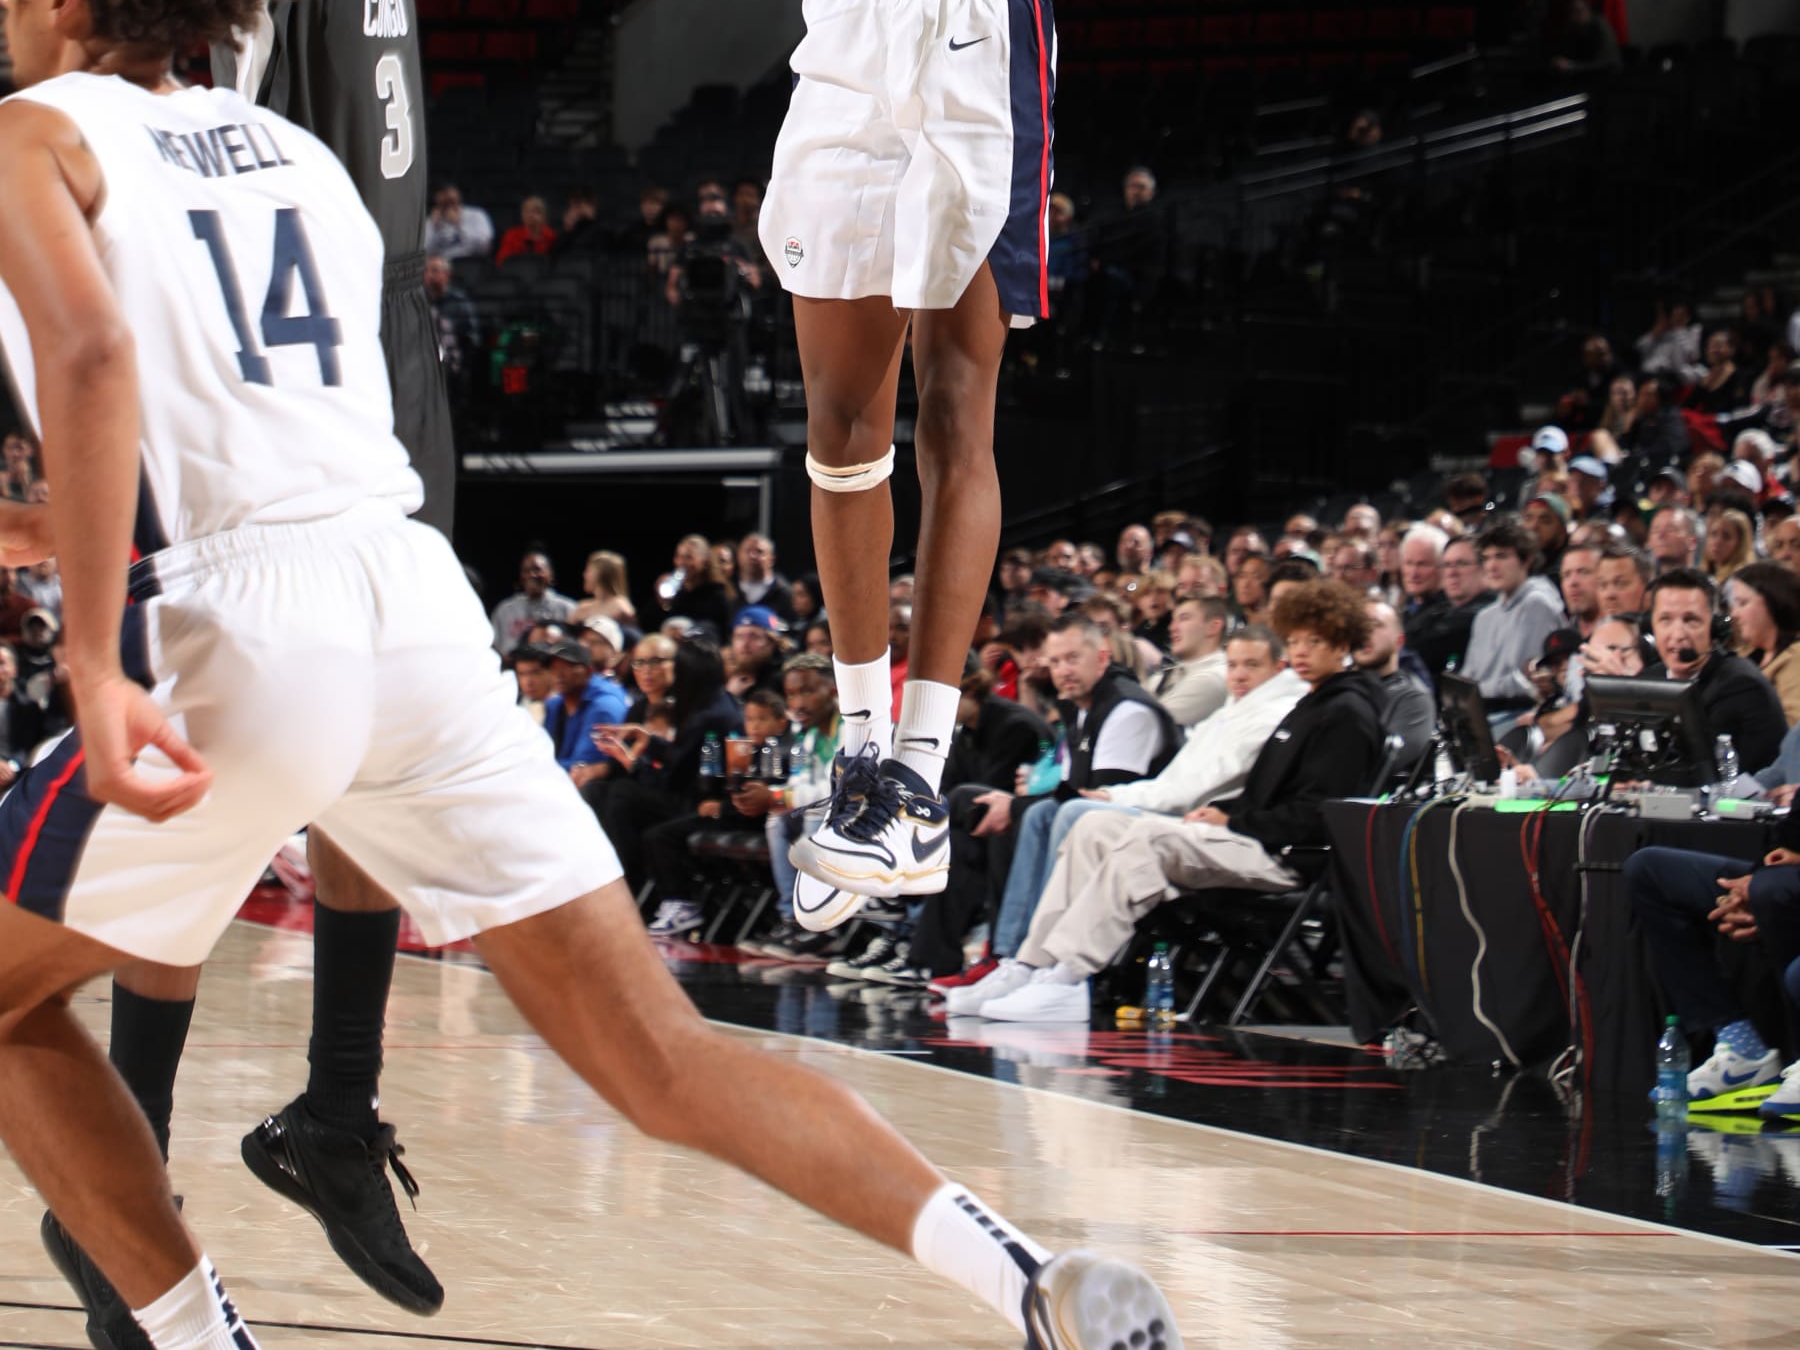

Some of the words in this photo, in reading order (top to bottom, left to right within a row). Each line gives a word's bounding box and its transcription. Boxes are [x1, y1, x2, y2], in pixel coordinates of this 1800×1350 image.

[143, 123, 295, 178] NEWELL
[375, 55, 413, 180] 3
[187, 208, 343, 386] 14
